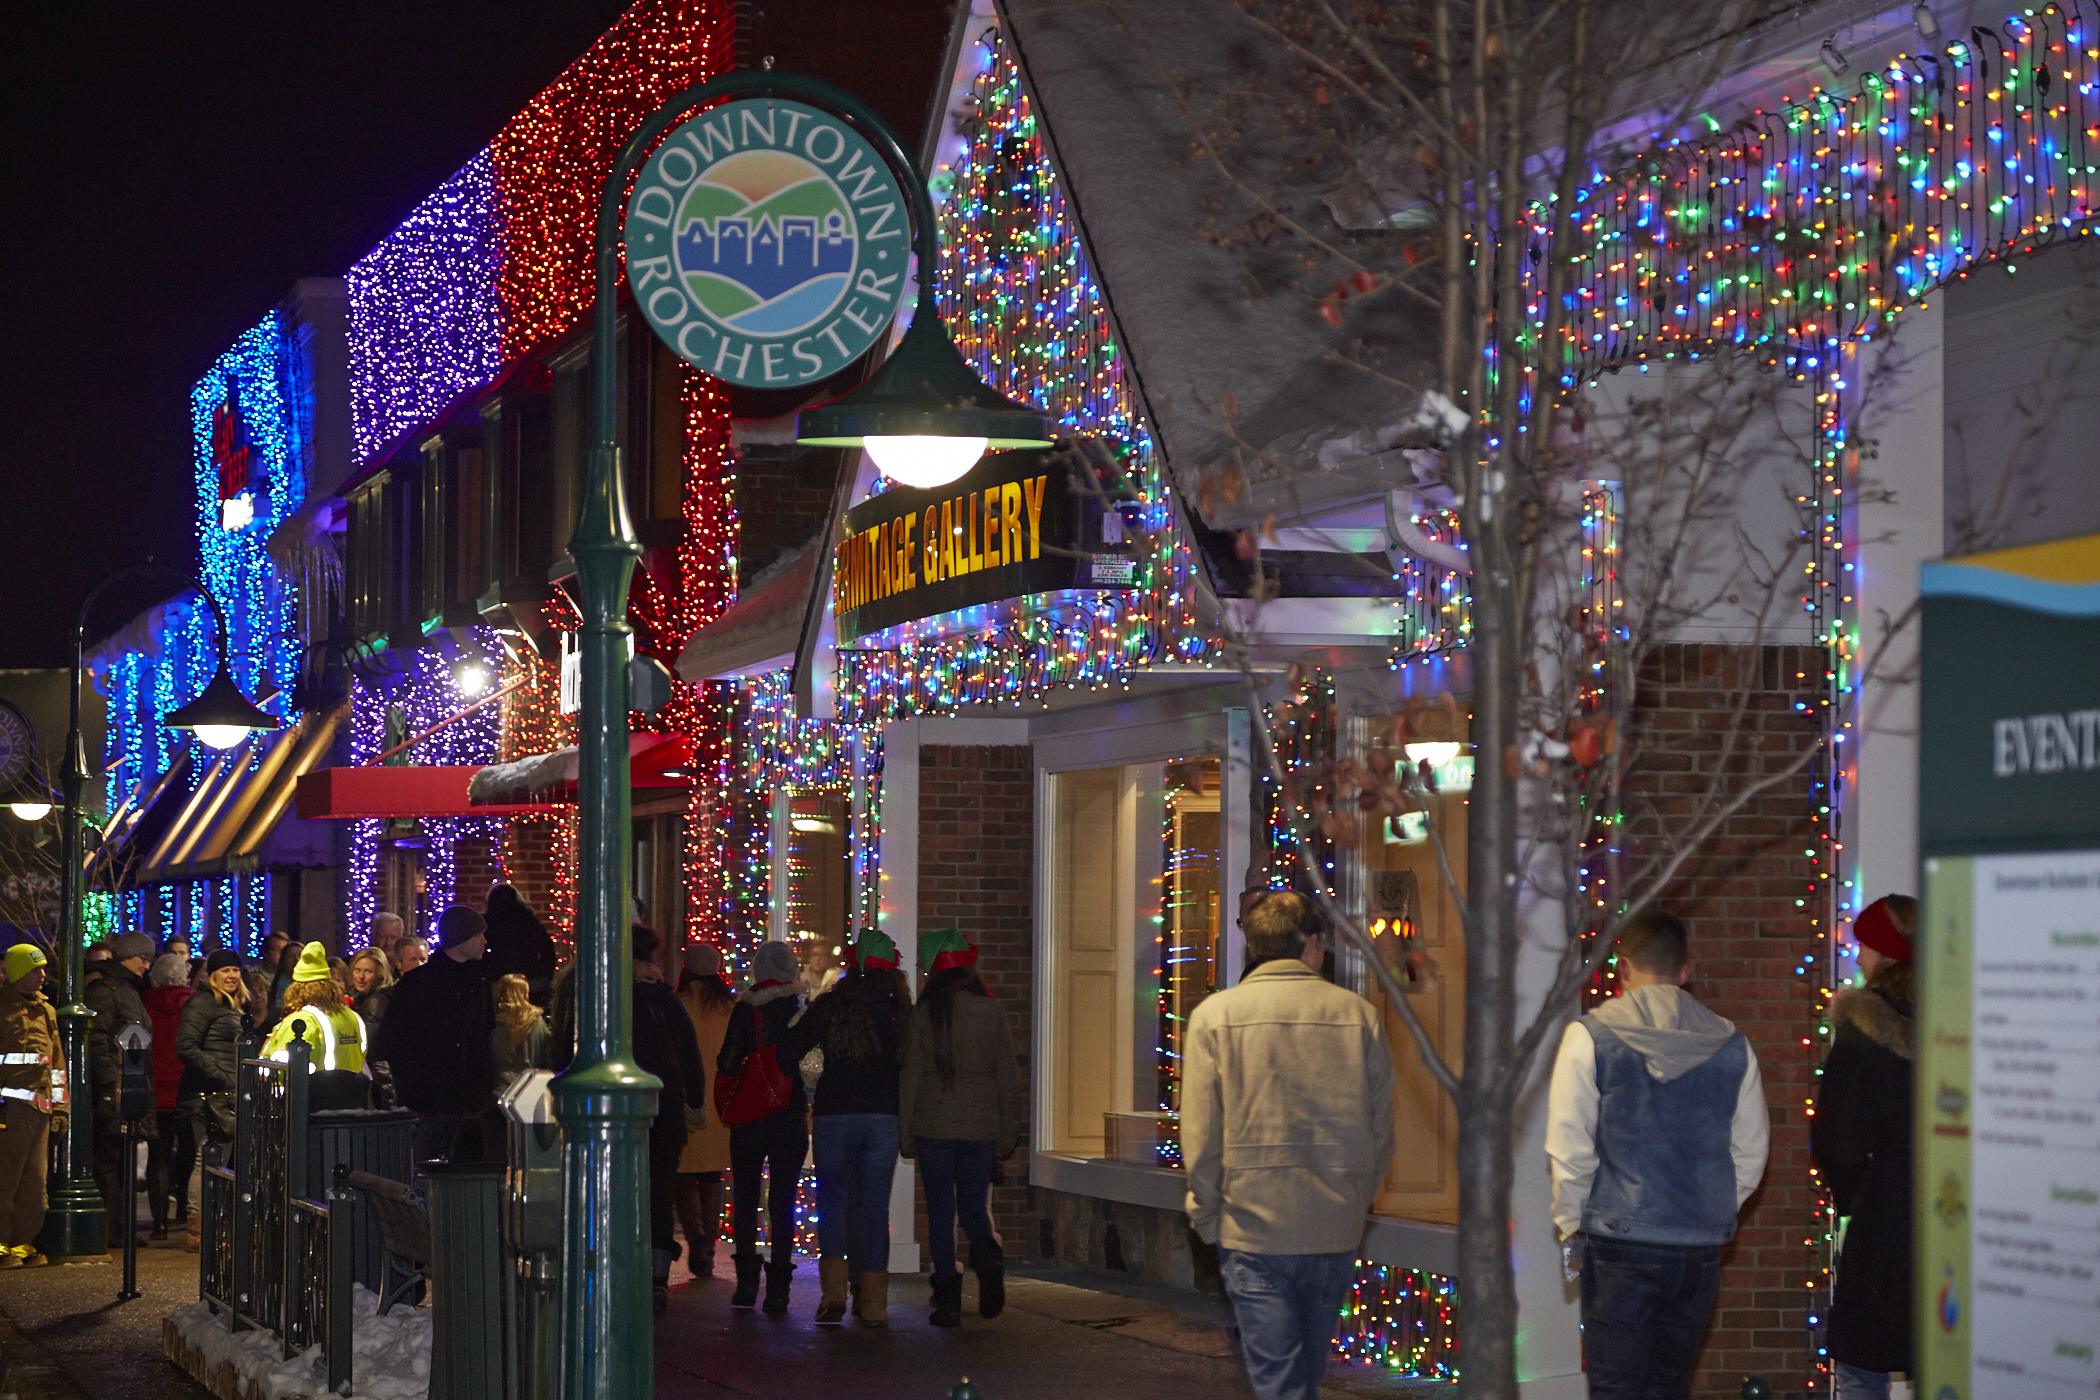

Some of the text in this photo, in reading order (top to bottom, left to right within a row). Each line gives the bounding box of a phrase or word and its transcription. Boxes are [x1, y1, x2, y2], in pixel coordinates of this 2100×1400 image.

[634, 108, 902, 241] DOWNTOWN
[633, 255, 898, 382] ROCHESTER
[923, 475, 1048, 585] GALLERY
